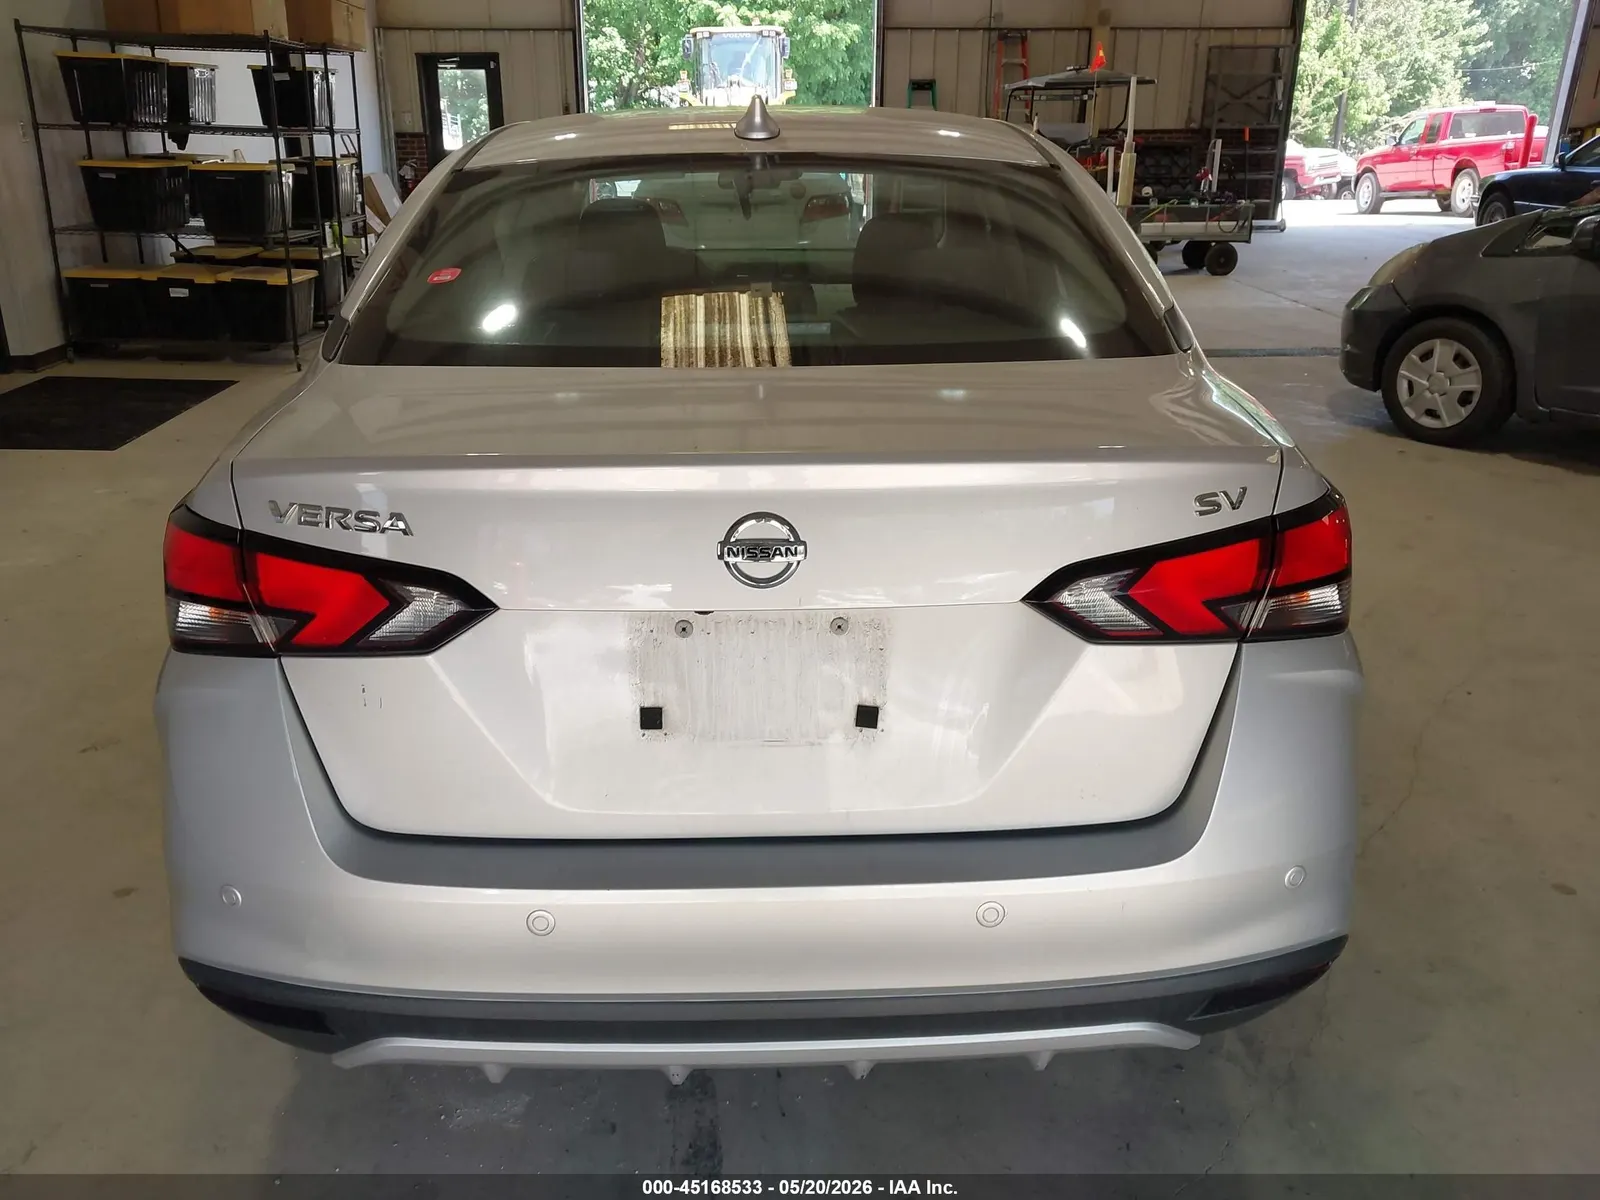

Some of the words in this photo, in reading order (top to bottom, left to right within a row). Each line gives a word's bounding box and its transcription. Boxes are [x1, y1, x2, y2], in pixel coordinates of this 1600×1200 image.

[1193, 486, 1248, 517] SV
[268, 499, 414, 537] VERSA
[725, 545, 799, 559] NISSAN
